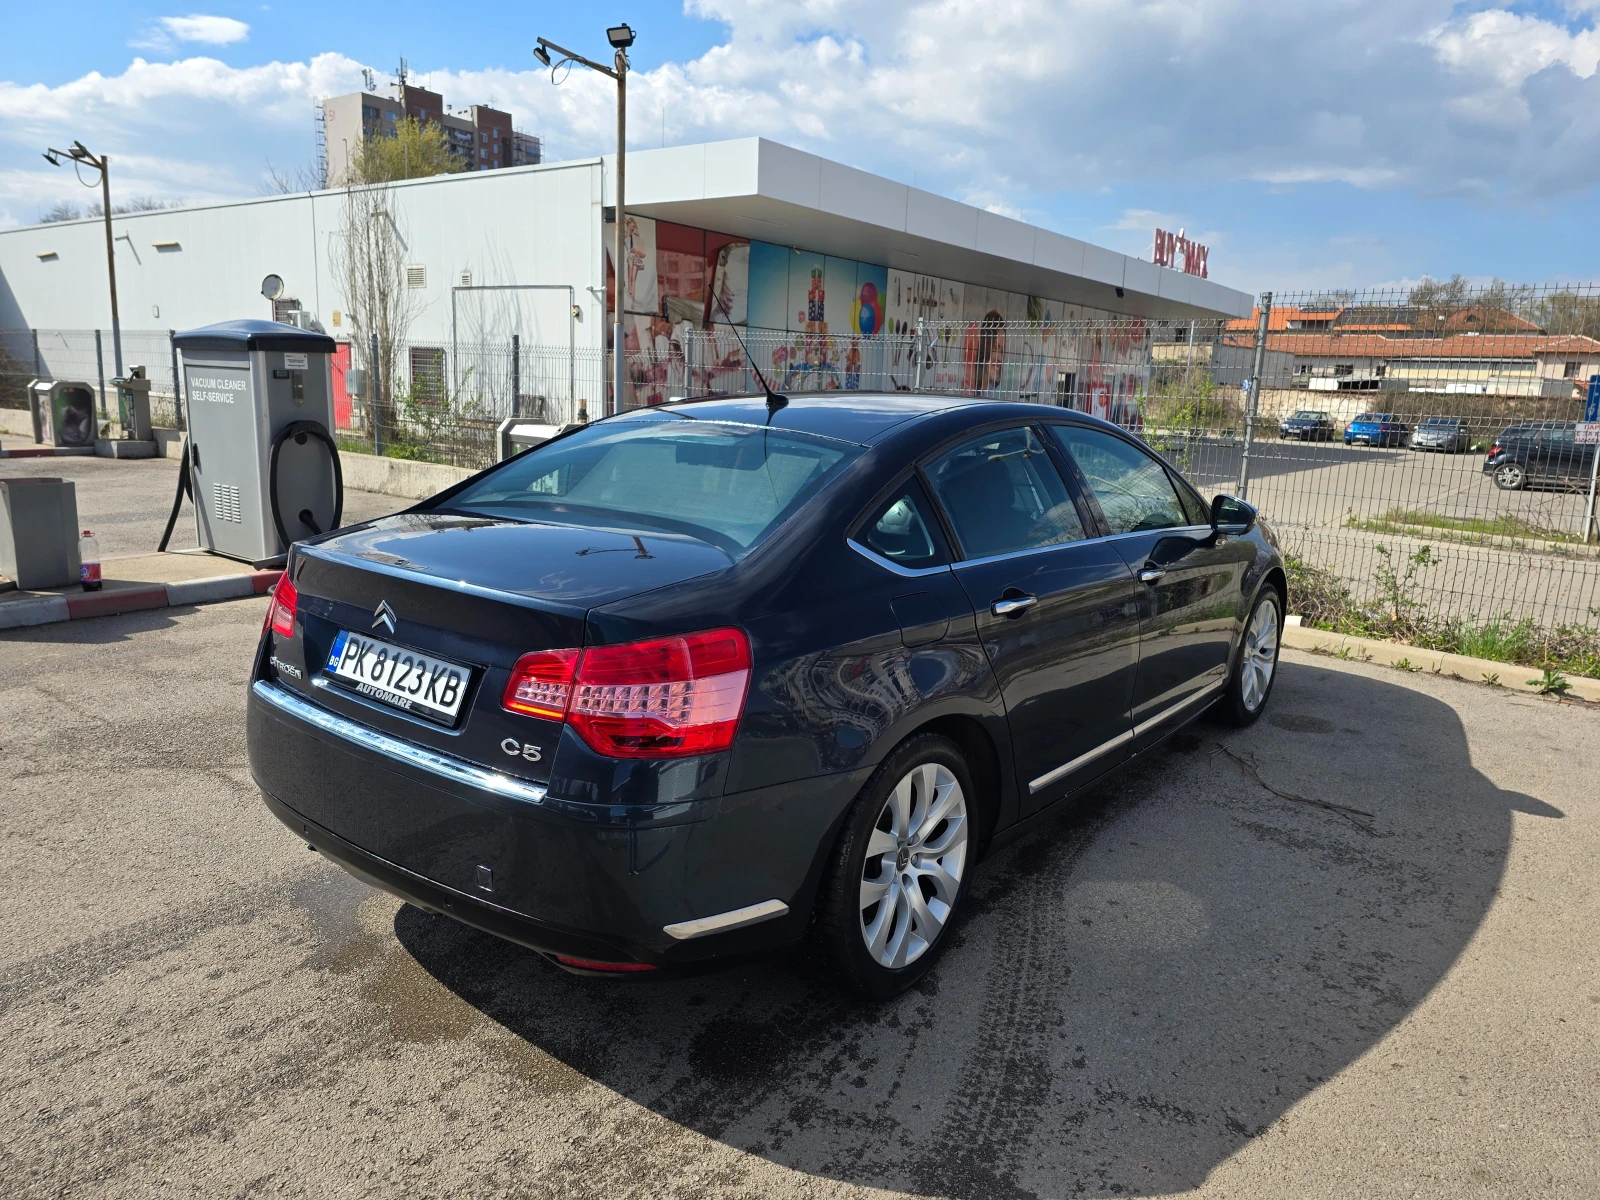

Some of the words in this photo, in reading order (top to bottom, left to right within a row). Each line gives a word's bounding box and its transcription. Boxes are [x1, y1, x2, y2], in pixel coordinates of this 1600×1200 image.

[1152, 227, 1177, 269] BUY
[1183, 239, 1209, 279] MAX
[190, 377, 217, 389] VACUUM
[216, 379, 247, 391] CLEANER
[192, 390, 235, 404] SELF-SERVICE
[328, 655, 340, 667] BG
[355, 682, 413, 710] AUTOMARE
[500, 738, 542, 762] C5
